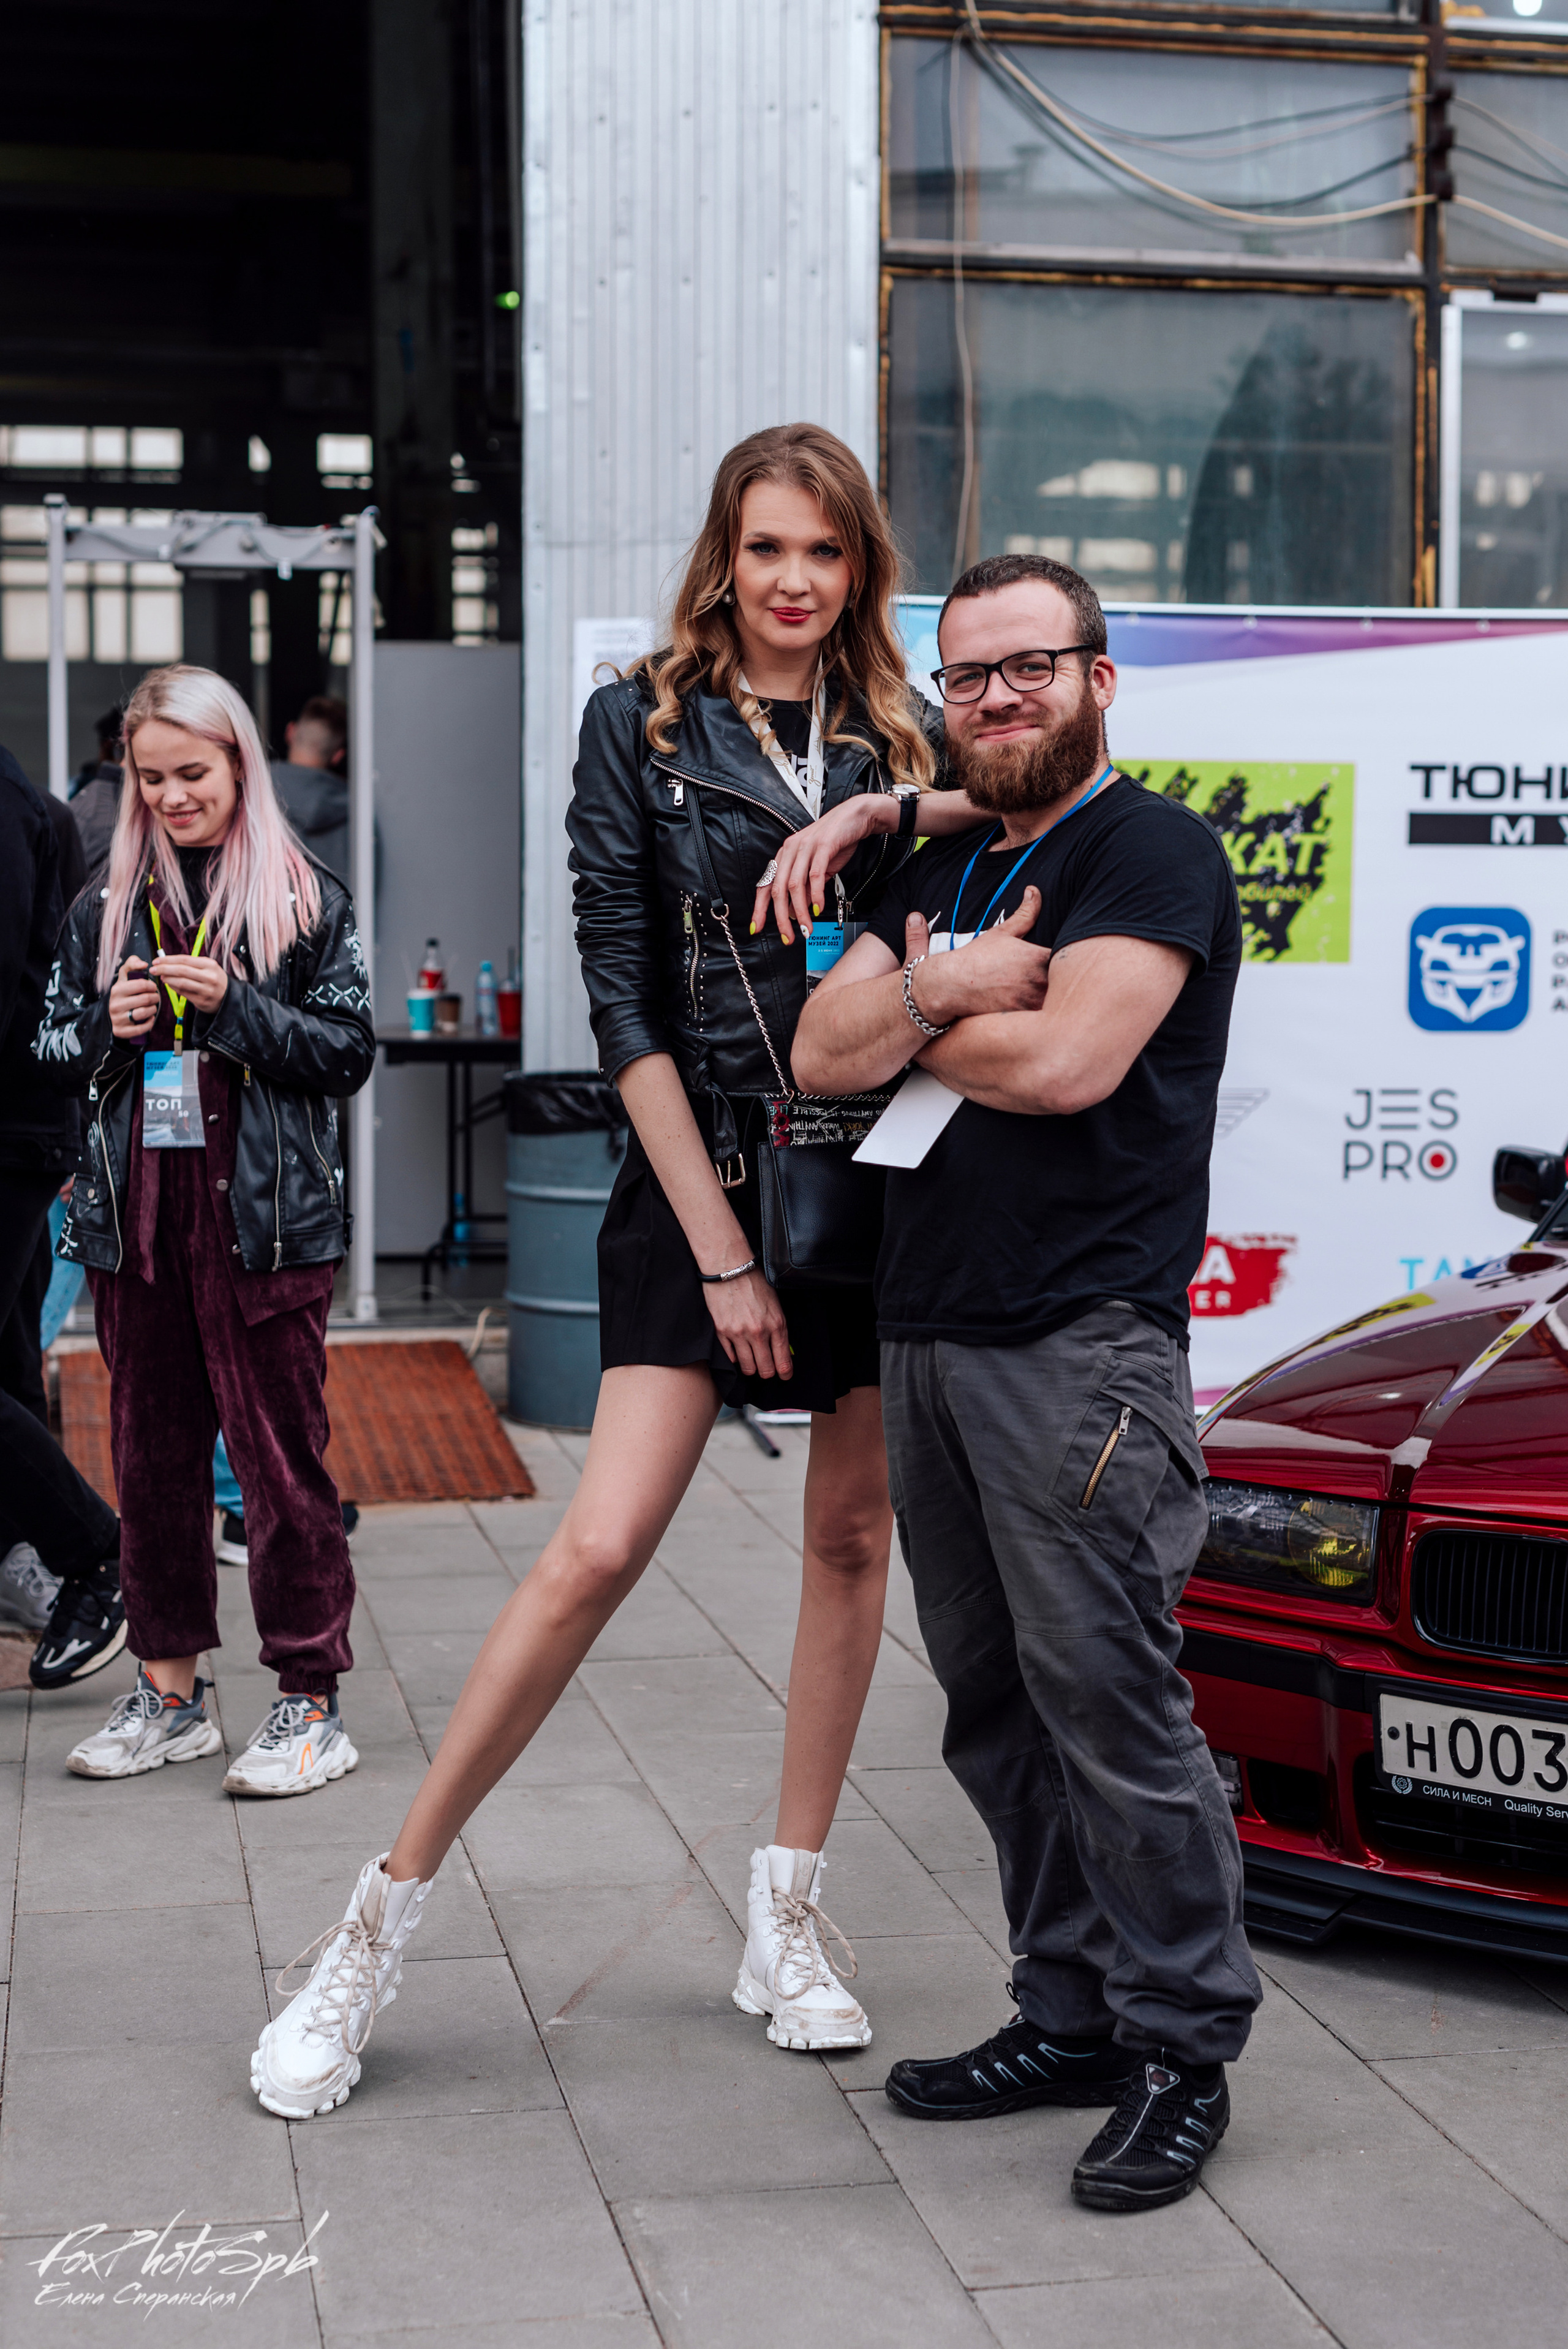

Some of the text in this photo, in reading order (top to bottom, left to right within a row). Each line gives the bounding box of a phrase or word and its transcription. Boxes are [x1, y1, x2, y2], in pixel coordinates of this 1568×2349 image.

[1410, 765, 1568, 799] ТЮН
[145, 1099, 182, 1111] ТОП
[1346, 1089, 1458, 1130] JES
[786, 1120, 819, 1132] ANYTHIN
[1344, 1140, 1457, 1181] PRO
[1423, 1785, 1450, 1799] СИЛА
[1453, 1791, 1460, 1801] И
[1504, 1799, 1543, 1817] Quality
